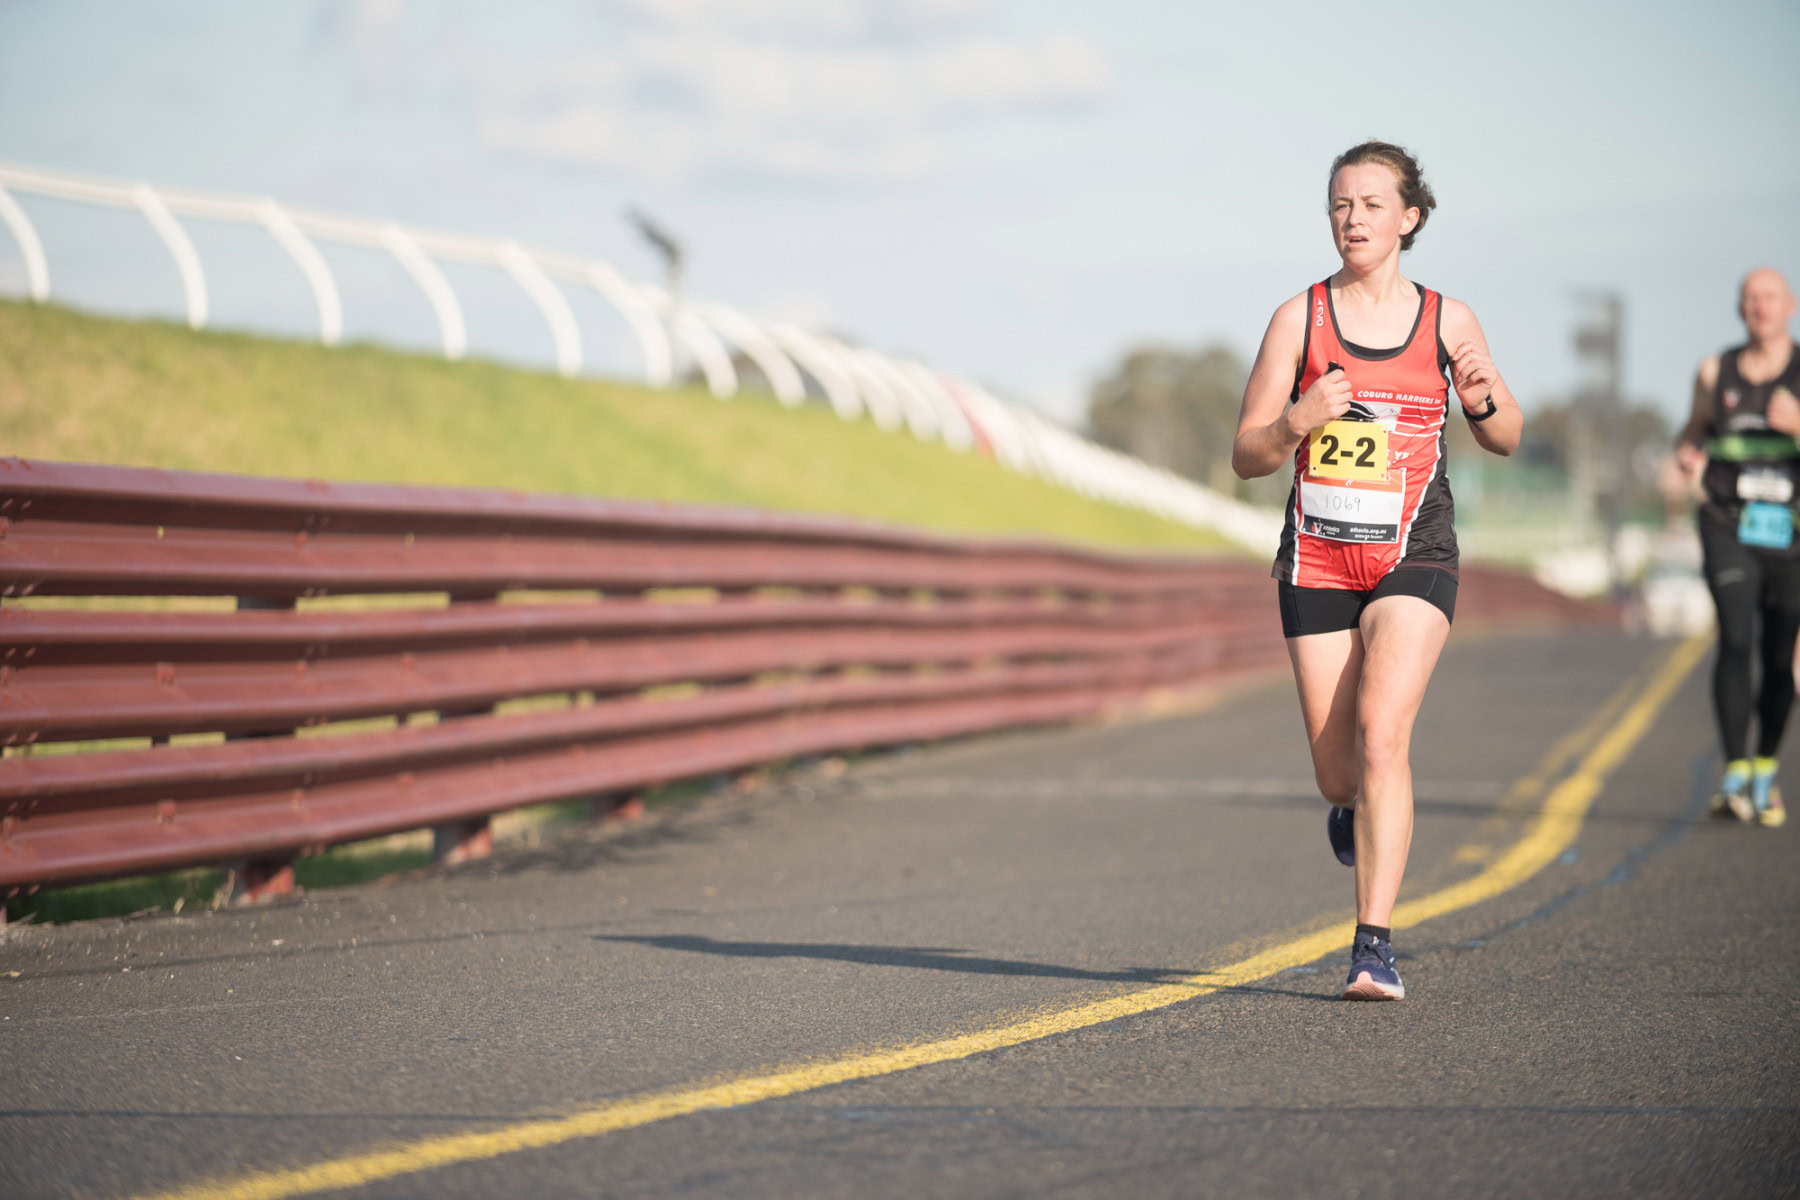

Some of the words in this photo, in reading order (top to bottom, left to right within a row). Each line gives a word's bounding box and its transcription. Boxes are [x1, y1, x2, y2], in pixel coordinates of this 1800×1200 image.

[1357, 390, 1393, 400] COBURG
[1395, 393, 1434, 405] HARRIERS
[1320, 434, 1376, 468] 2-2
[1325, 494, 1361, 512] 1069
